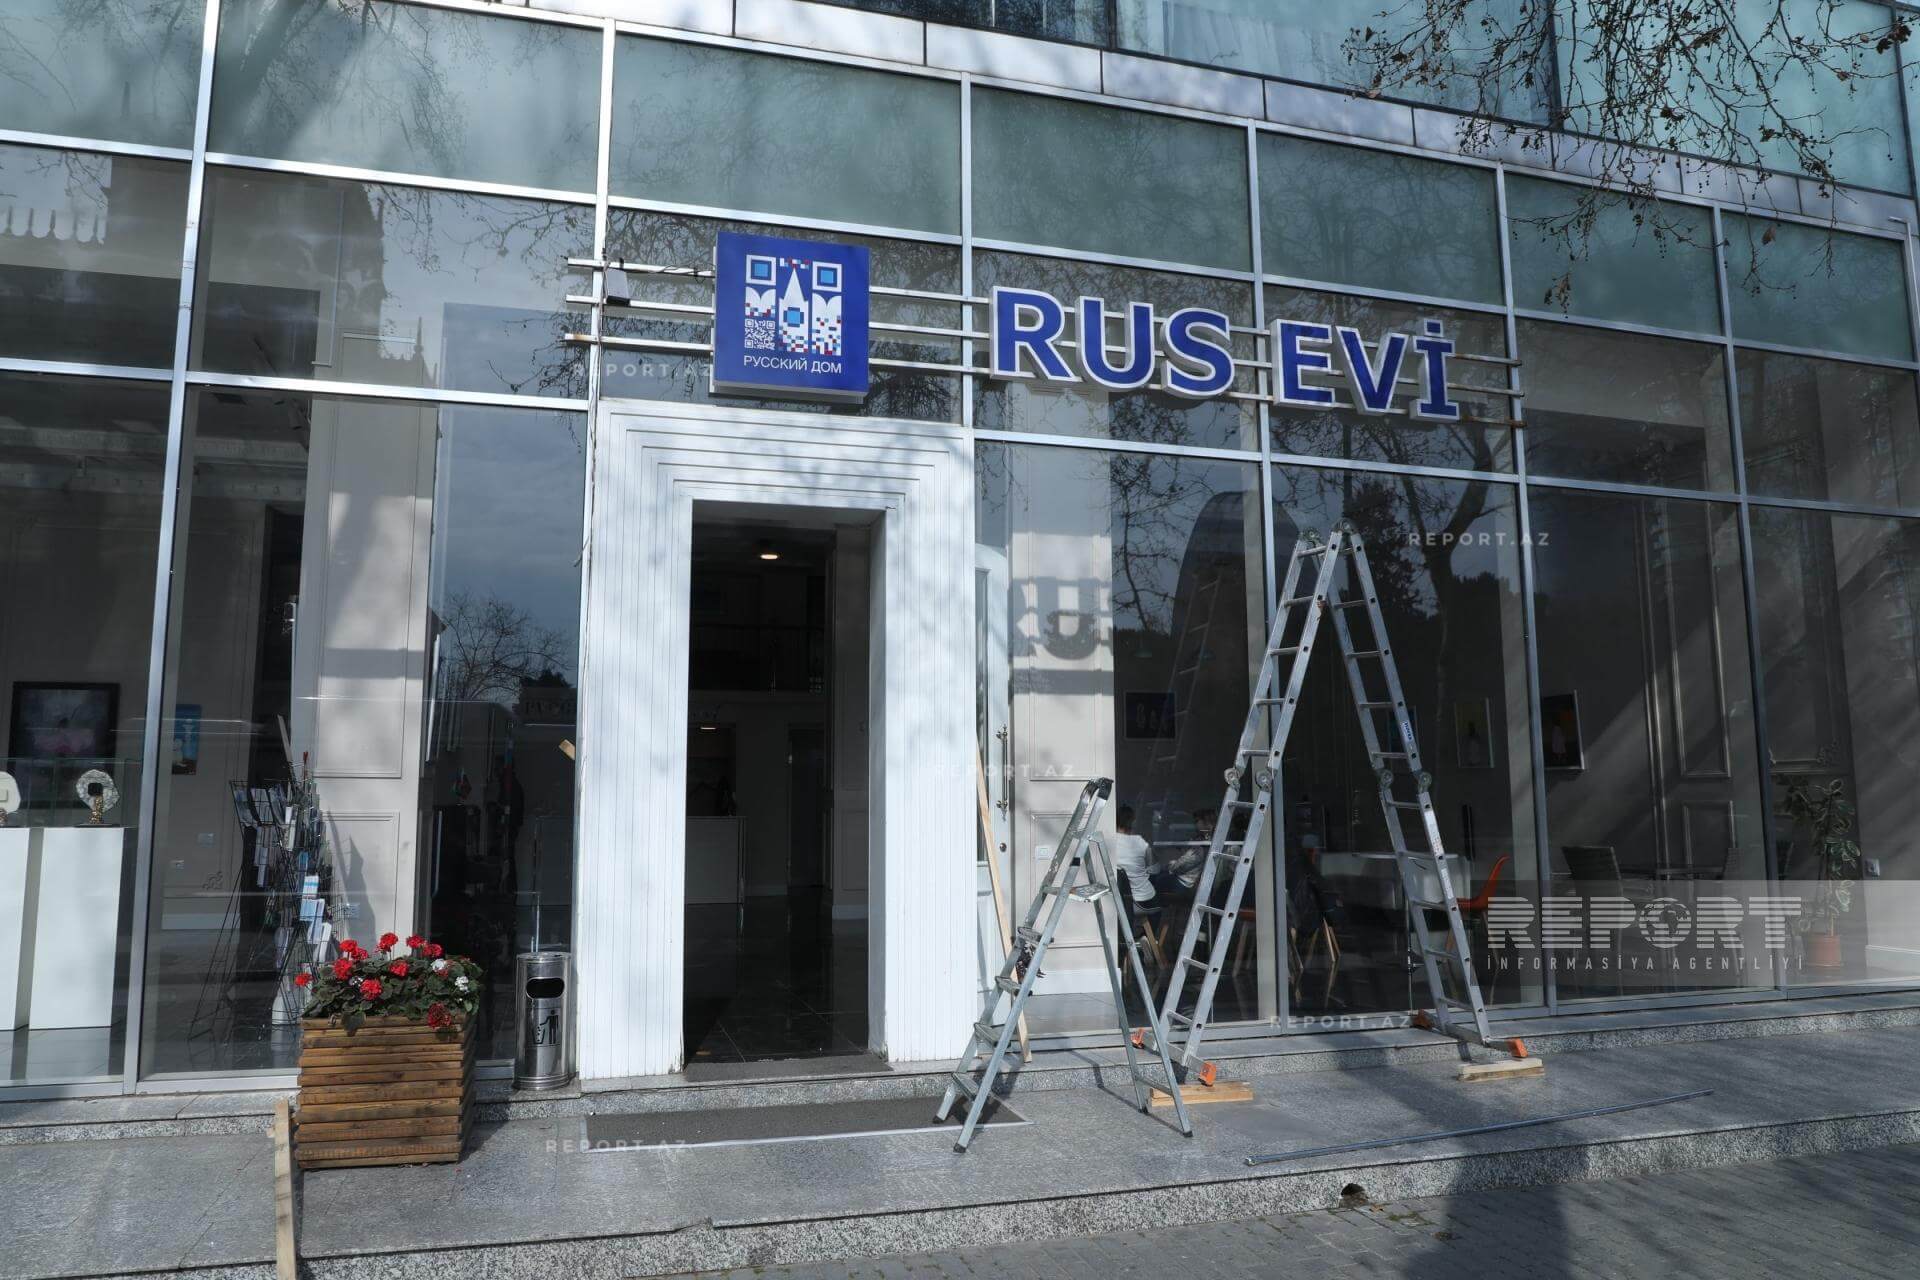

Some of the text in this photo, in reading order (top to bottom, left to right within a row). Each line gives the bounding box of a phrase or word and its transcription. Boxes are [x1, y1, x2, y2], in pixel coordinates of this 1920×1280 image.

[743, 354, 842, 374] РУССКИЙ ДОМ
[989, 285, 1461, 422] RUS EVİ
